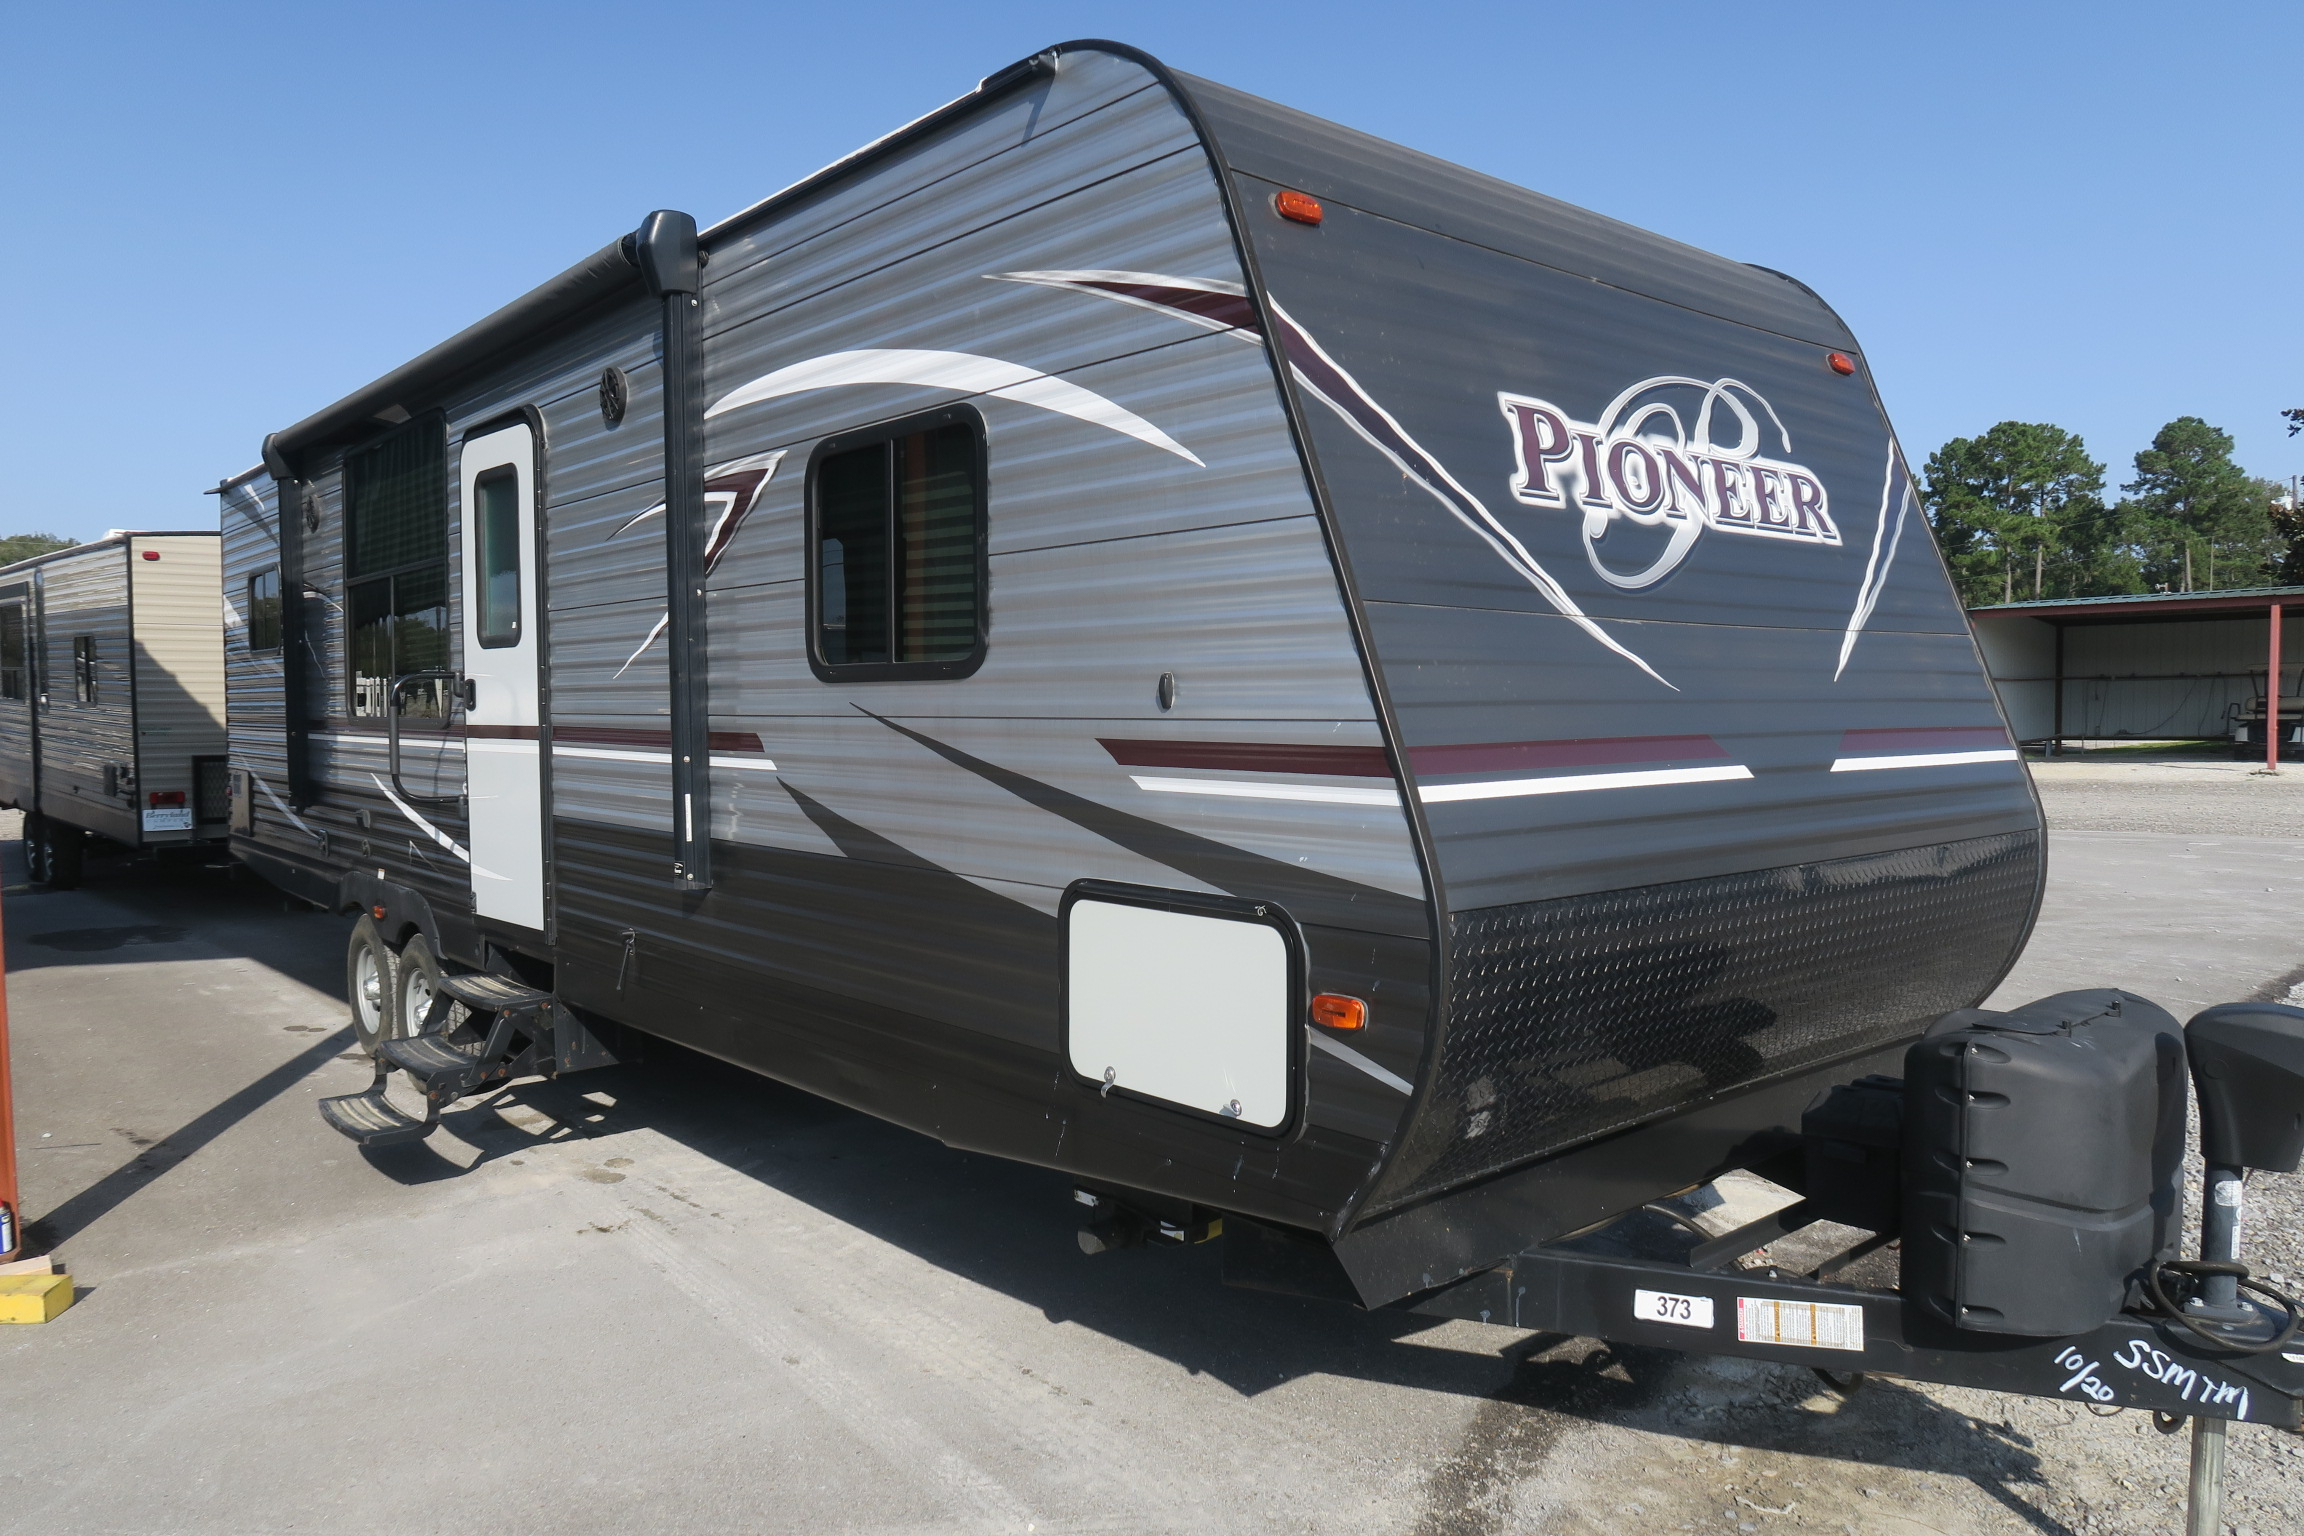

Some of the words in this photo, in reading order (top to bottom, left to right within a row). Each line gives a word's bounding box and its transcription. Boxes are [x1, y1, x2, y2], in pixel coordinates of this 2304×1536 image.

[1498, 392, 1842, 546] PIONEER
[1657, 1296, 1691, 1319] 373
[2054, 1346, 2114, 1401] 10/20
